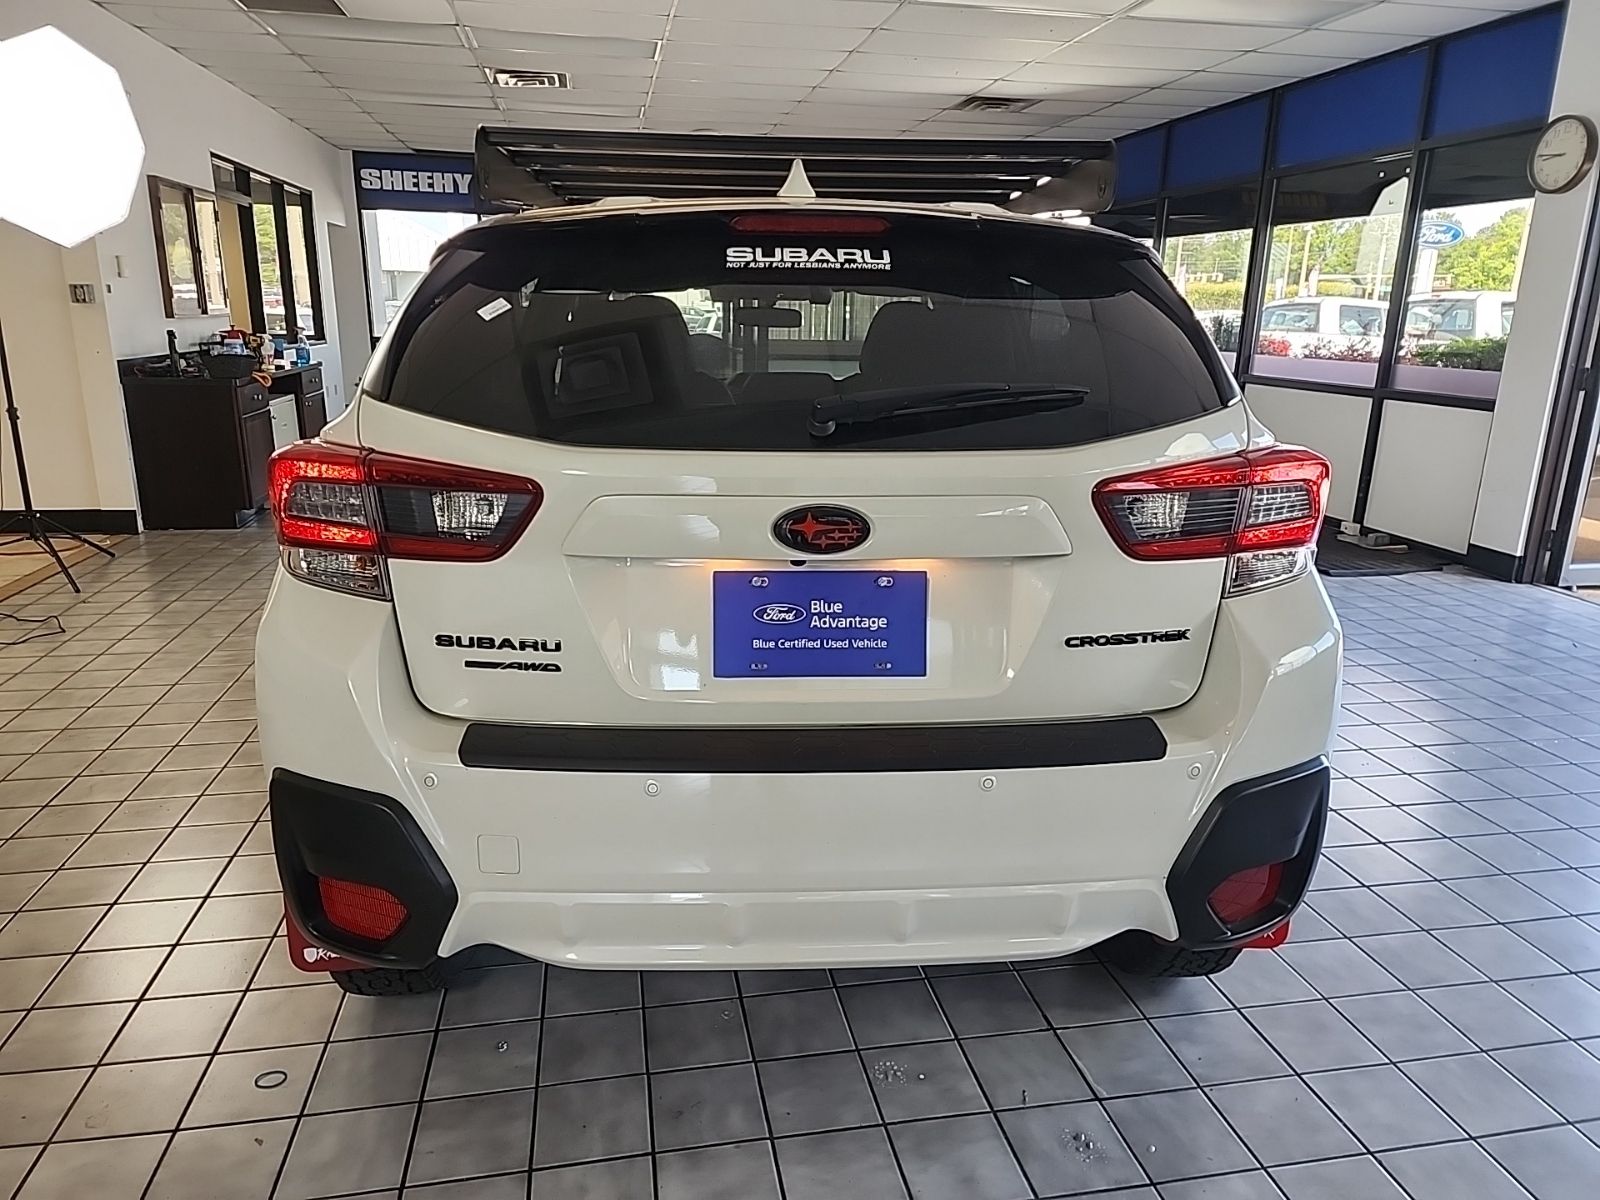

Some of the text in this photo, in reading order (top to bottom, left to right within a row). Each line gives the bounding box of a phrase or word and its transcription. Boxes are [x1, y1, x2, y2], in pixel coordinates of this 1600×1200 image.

[360, 168, 473, 194] SHEEHY
[726, 247, 891, 264] SUBARU
[843, 263, 891, 271] ANYMORE
[763, 606, 796, 621] Ford
[810, 600, 843, 613] Blue
[810, 615, 888, 631] Advantage
[434, 634, 562, 653] SUBARU
[752, 639, 888, 649] Blue Certified Used Vehicle
[1064, 628, 1191, 649] CROSSTREK
[499, 661, 562, 673] AWD
